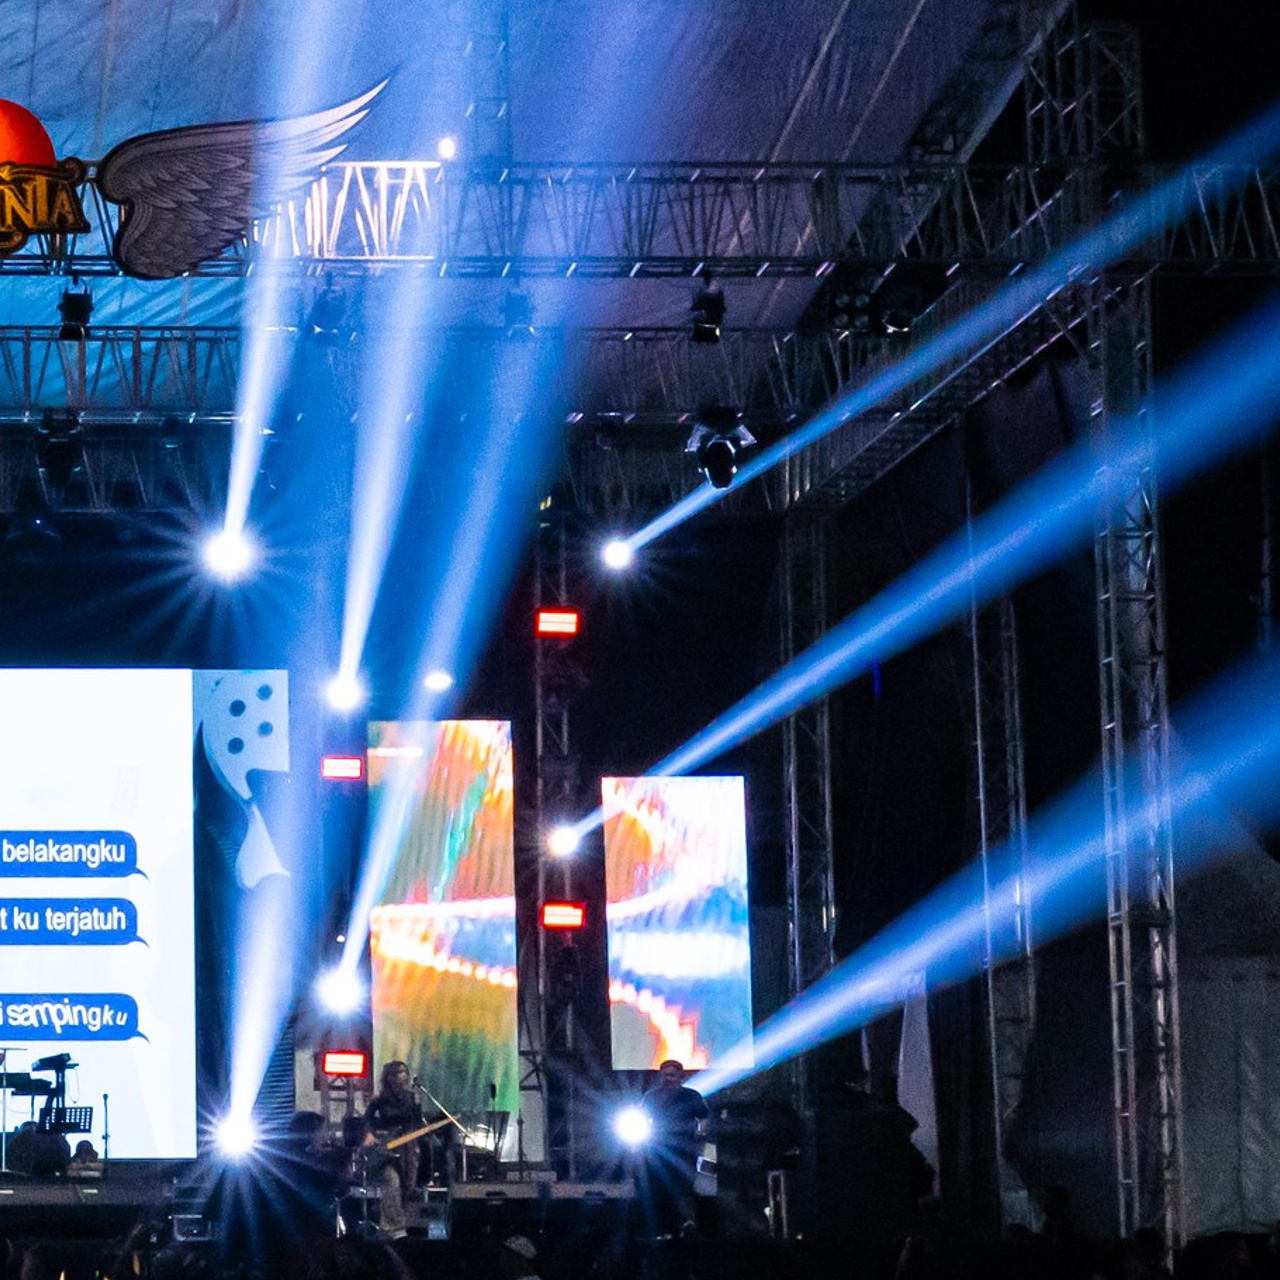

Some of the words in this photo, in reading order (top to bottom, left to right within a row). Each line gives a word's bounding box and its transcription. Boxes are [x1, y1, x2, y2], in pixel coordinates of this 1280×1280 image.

[2, 838, 126, 869] belakangku
[13, 906, 40, 931] ku
[44, 906, 127, 937] terjatuh
[5, 997, 128, 1034] sampingku
